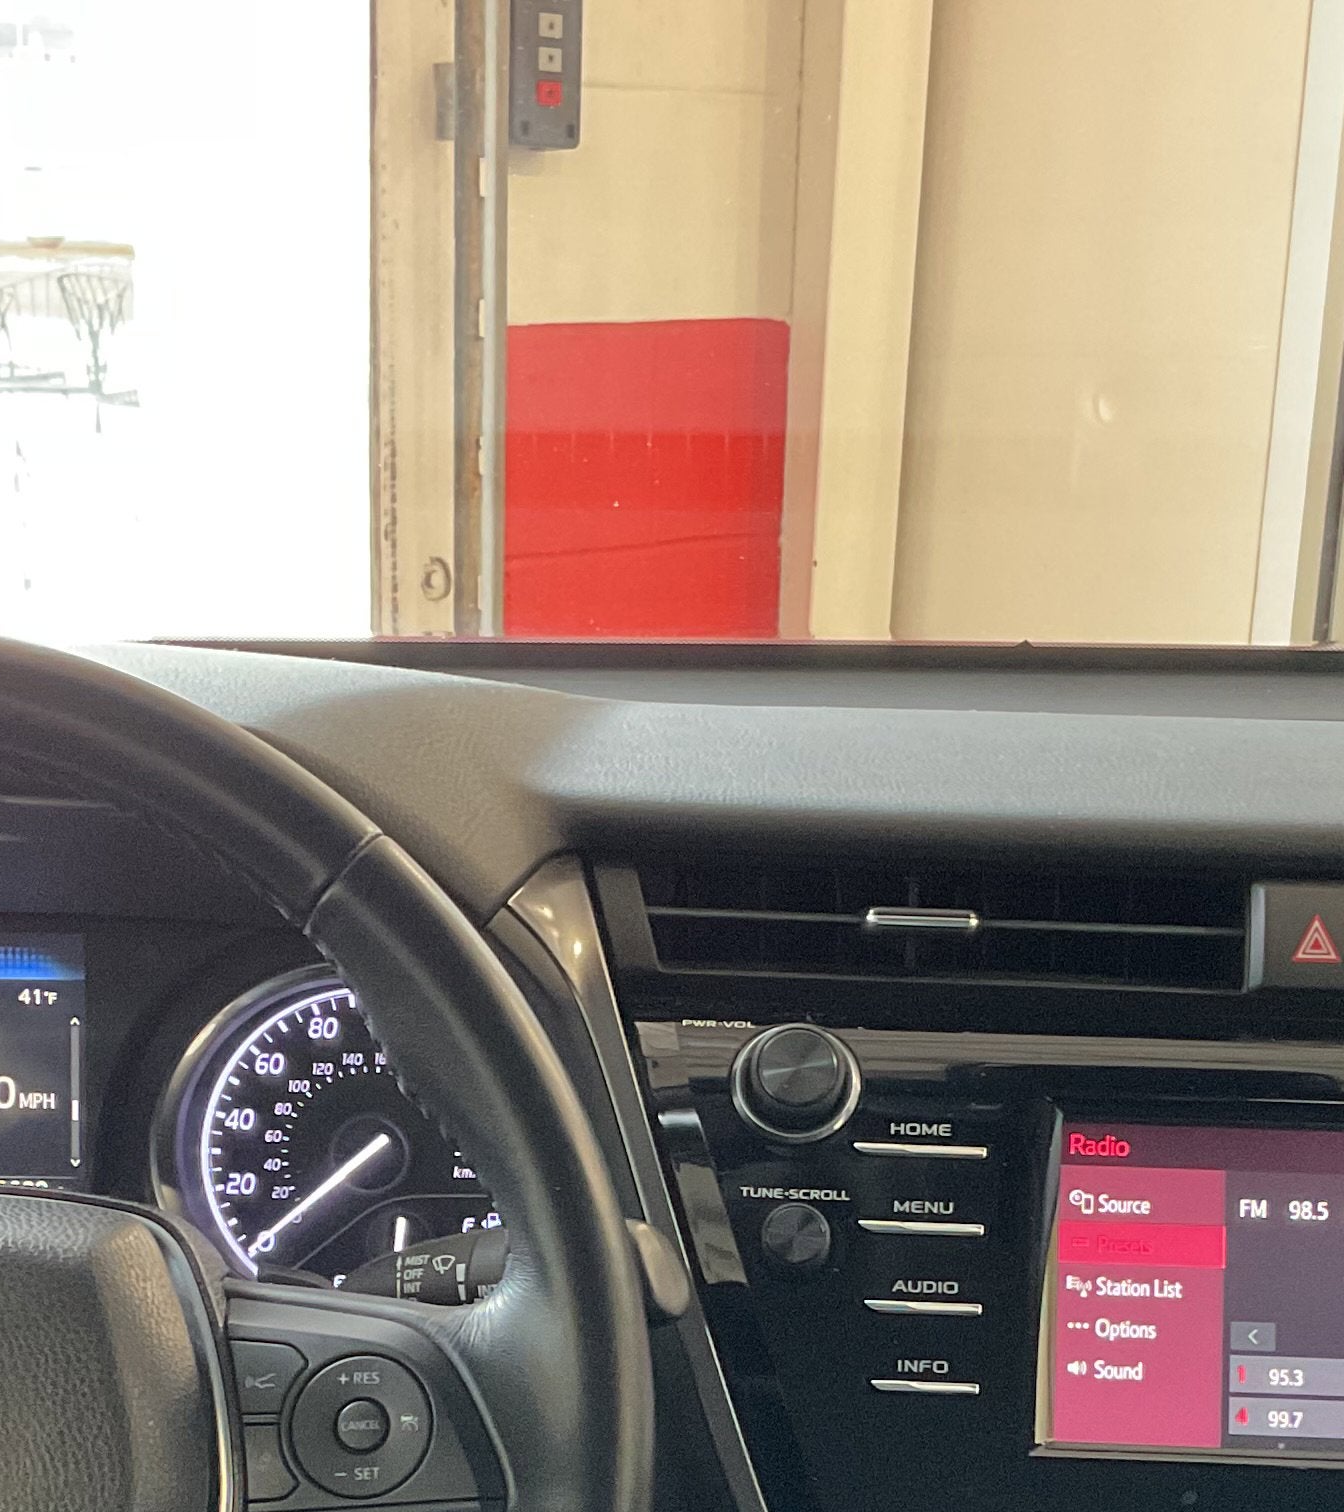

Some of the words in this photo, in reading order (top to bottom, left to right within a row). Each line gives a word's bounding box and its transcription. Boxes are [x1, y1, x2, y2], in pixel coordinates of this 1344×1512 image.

[307, 1017, 338, 1039] 80
[255, 1053, 285, 1075] 60
[342, 1052, 364, 1066] 140
[374, 1052, 387, 1066] 16
[312, 1062, 334, 1076] 120
[288, 1079, 311, 1093] 100
[18, 1091, 57, 1110] MPH
[274, 1102, 292, 1116] 80
[224, 1106, 255, 1131] 40
[264, 1130, 282, 1143] 60
[889, 1121, 953, 1138] HOME
[1068, 1132, 1131, 1158] Radio
[263, 1158, 282, 1171] 40
[225, 1172, 256, 1195] 20
[271, 1186, 289, 1199] 20
[893, 1199, 955, 1216] MENU
[1097, 1194, 1152, 1215] Source
[1238, 1198, 1269, 1219] FM
[1288, 1200, 1330, 1221] 98.5
[461, 1216, 476, 1234] F
[404, 1254, 431, 1266] MIST
[403, 1268, 424, 1280] OFF
[403, 1281, 422, 1294] INT
[892, 1278, 960, 1295] AUDIO
[1095, 1275, 1152, 1298] Station
[1153, 1279, 1183, 1299] List
[1094, 1317, 1158, 1342] Options
[896, 1359, 950, 1375] INFO
[1093, 1359, 1144, 1381] Sound
[1268, 1368, 1305, 1387] 95.3
[340, 1419, 381, 1432] CANCEL
[1267, 1411, 1304, 1430] 99.7
